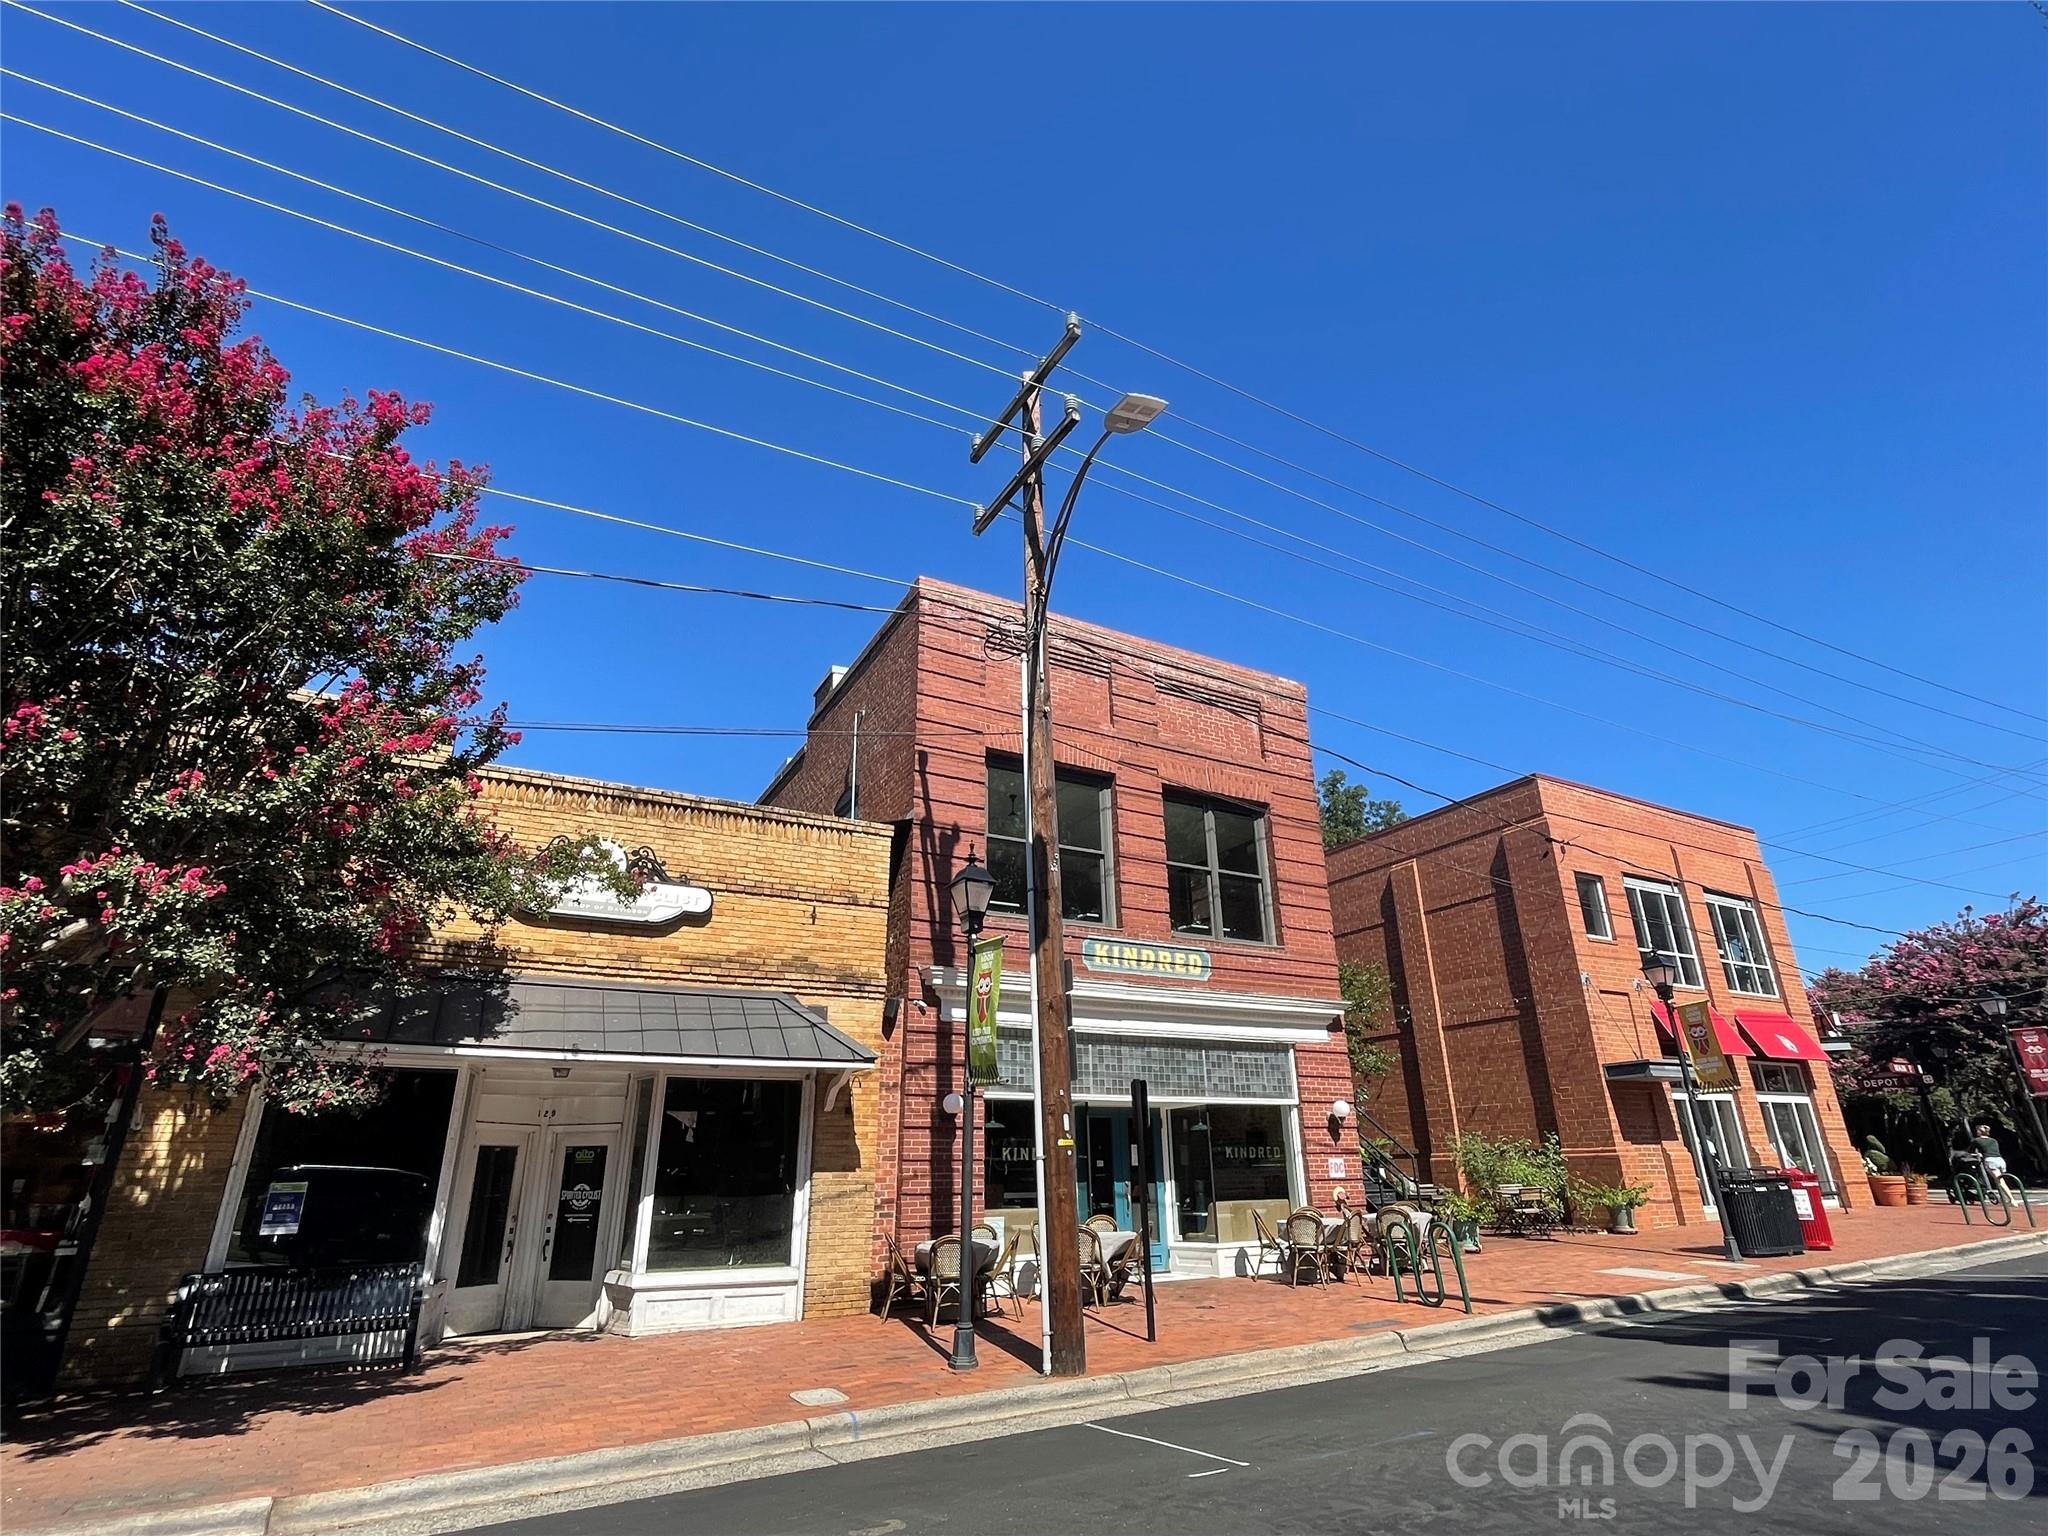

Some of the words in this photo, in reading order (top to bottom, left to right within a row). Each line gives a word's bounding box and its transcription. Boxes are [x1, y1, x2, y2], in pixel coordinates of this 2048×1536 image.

[1094, 943, 1203, 975] KINDRED
[1863, 1078, 1899, 1088] DEPOT
[537, 1109, 557, 1119] 129
[1225, 1145, 1281, 1160] KINDRED
[1328, 1161, 1345, 1174] FDC
